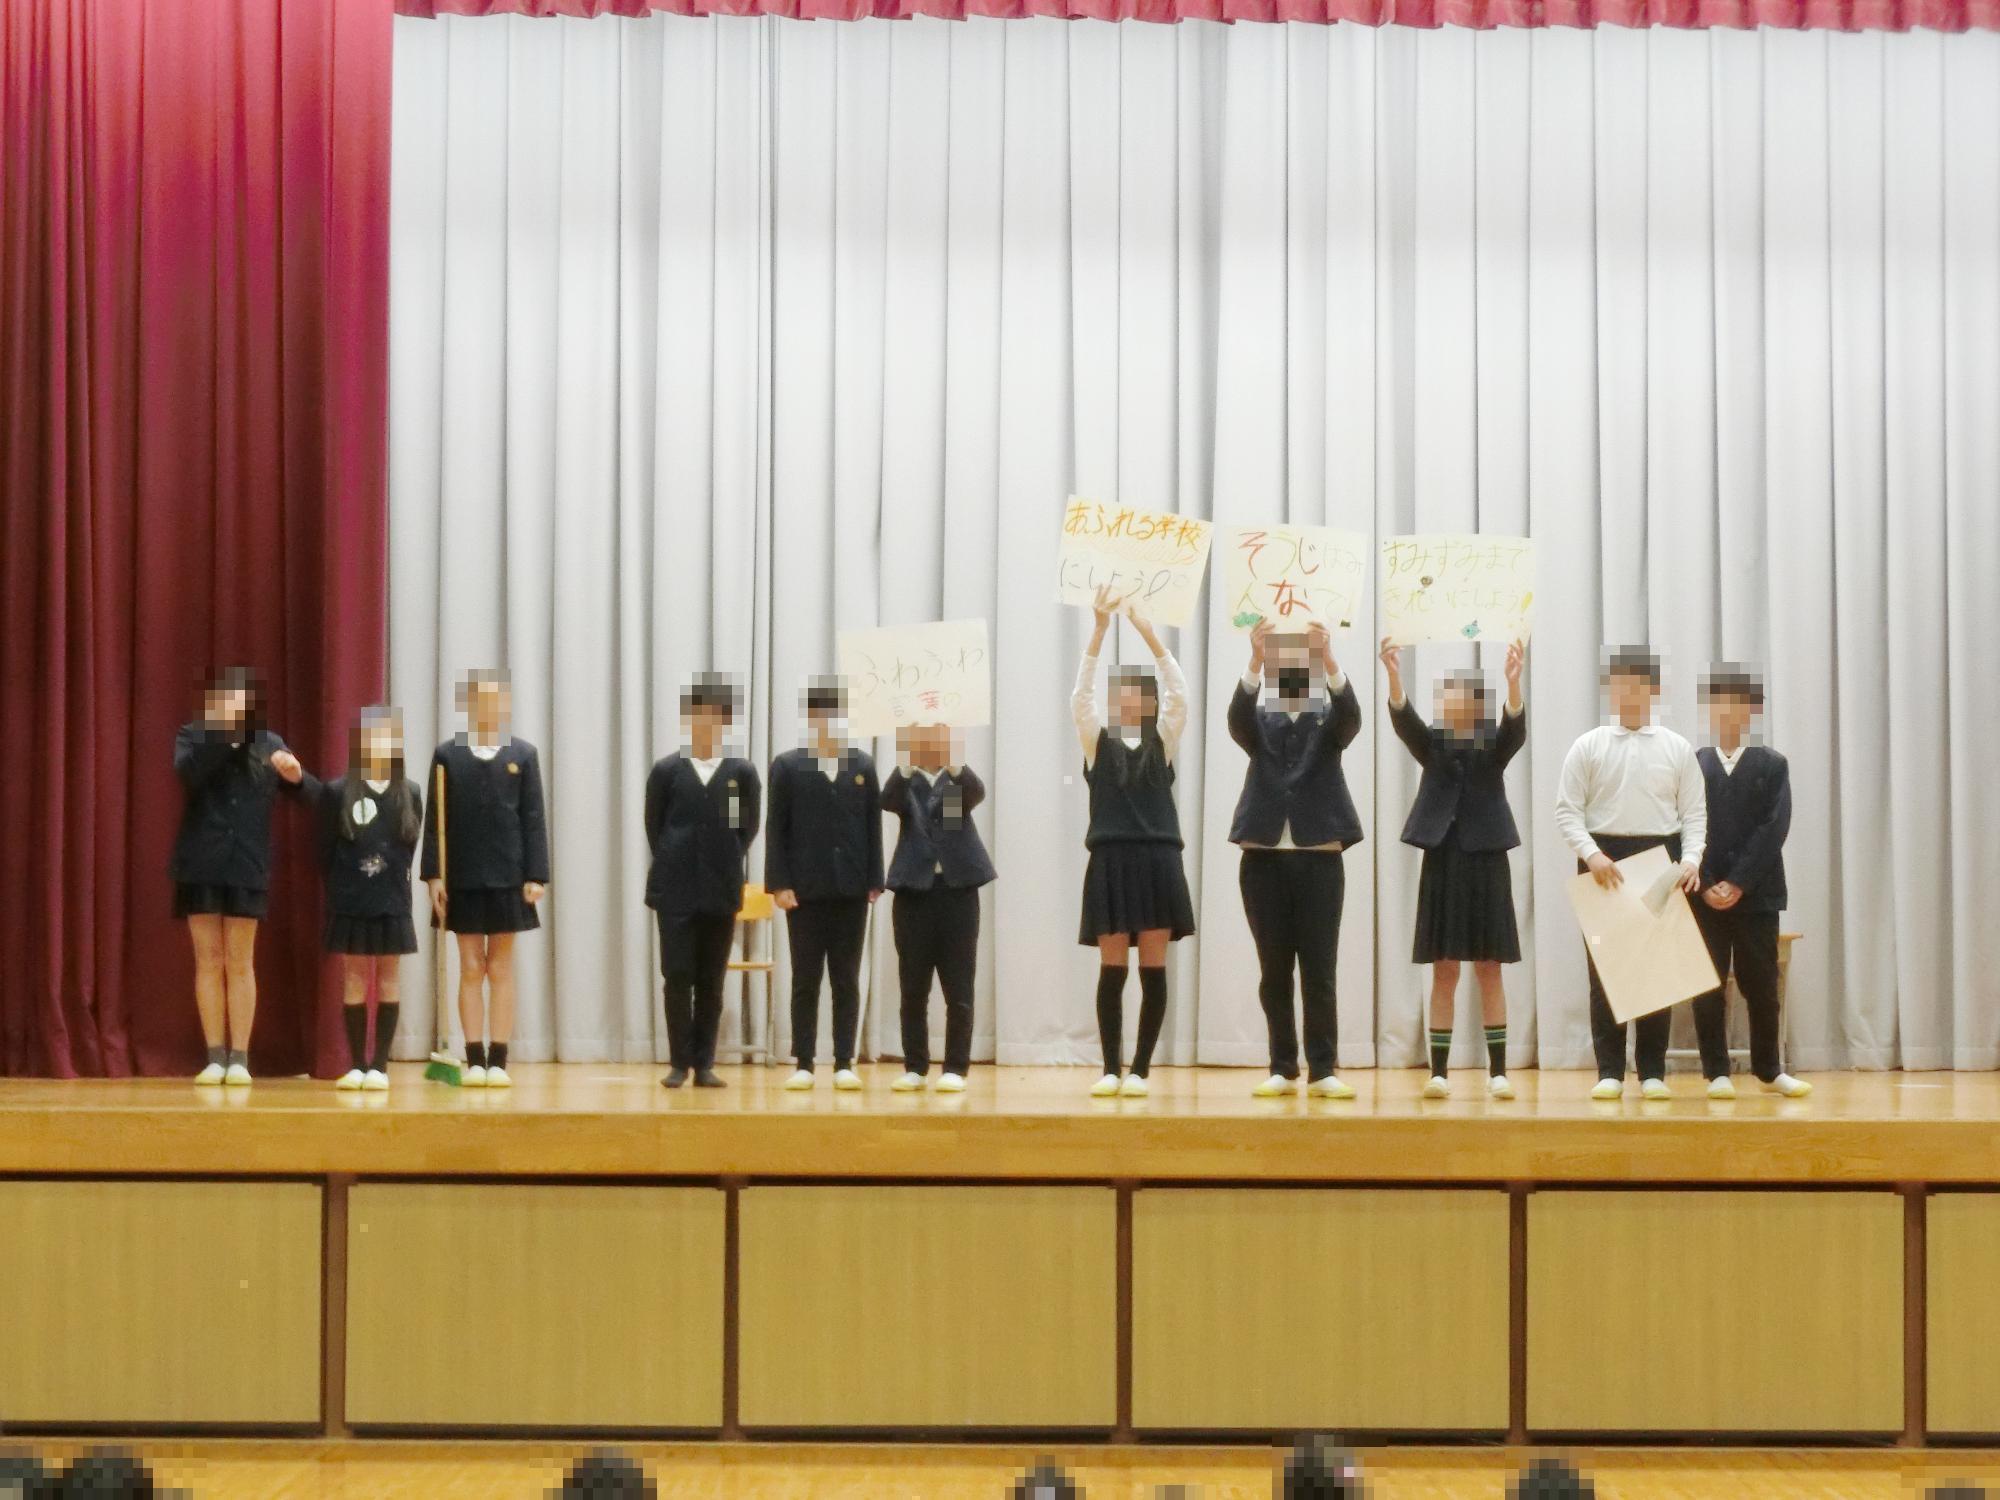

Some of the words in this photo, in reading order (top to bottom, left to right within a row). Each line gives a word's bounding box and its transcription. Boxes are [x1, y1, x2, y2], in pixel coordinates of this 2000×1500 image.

[1064, 501, 1202, 552] あふれる学校
[855, 647, 985, 698] ふわふわ
